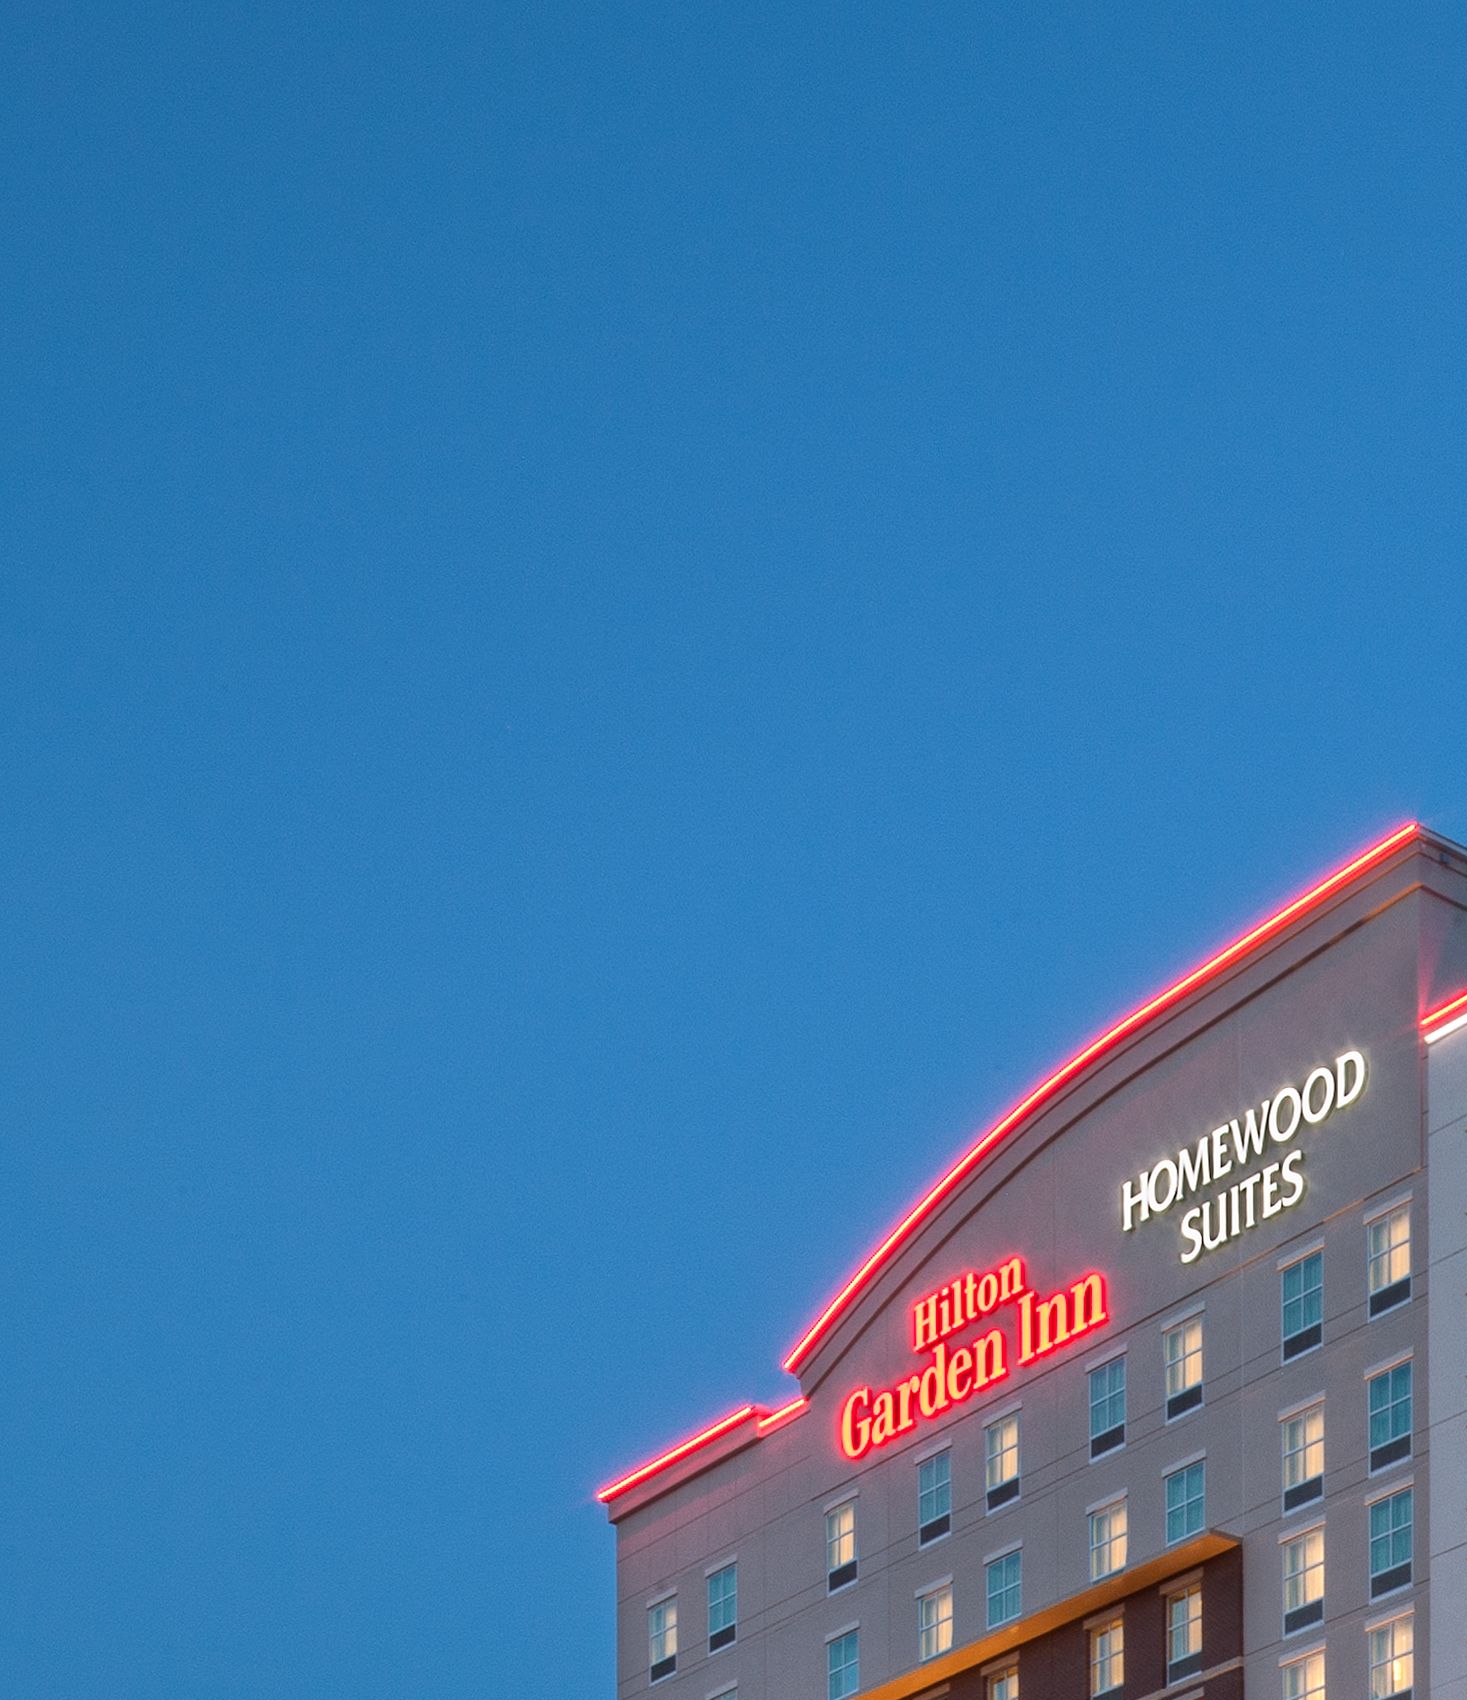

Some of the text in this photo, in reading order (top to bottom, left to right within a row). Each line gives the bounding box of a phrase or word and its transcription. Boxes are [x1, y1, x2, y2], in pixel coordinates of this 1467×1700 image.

[1121, 1049, 1367, 1233] HOMEWOOD
[1179, 1149, 1305, 1265] SUITES
[840, 1272, 1108, 1459] Garden Inn
[912, 1256, 1025, 1353] Hilton
